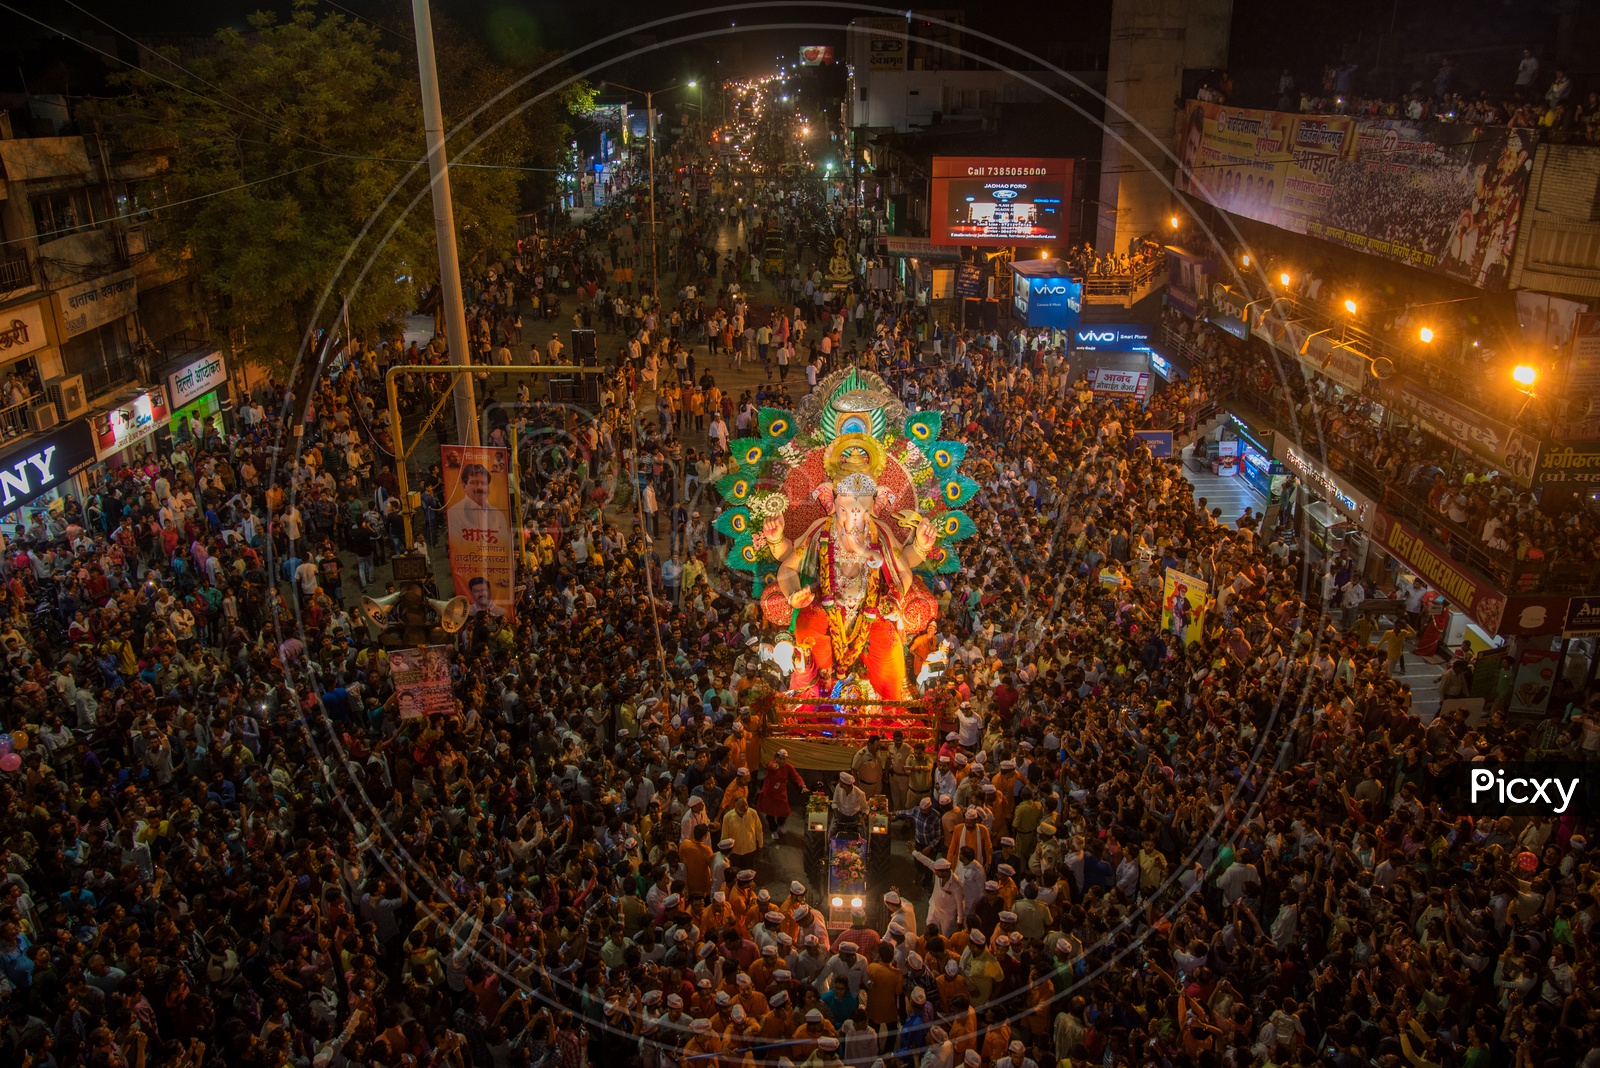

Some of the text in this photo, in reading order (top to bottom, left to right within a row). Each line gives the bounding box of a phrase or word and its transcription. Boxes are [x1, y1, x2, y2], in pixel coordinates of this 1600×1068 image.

[1383, 136, 1397, 150] 27
[968, 167, 1047, 177] Call 7385055000
[1383, 160, 1389, 173] 3
[1391, 240, 1411, 259] निरोप
[101, 277, 135, 298] दवाखाना
[1035, 284, 1066, 295] vivo
[1079, 330, 1115, 342] vivo
[174, 369, 195, 394] दिल्ली
[1103, 372, 1133, 384] आनंद
[0, 445, 56, 507] NY
[461, 527, 499, 545] भाऊ
[1388, 522, 1476, 609] DESI BURGERKING
